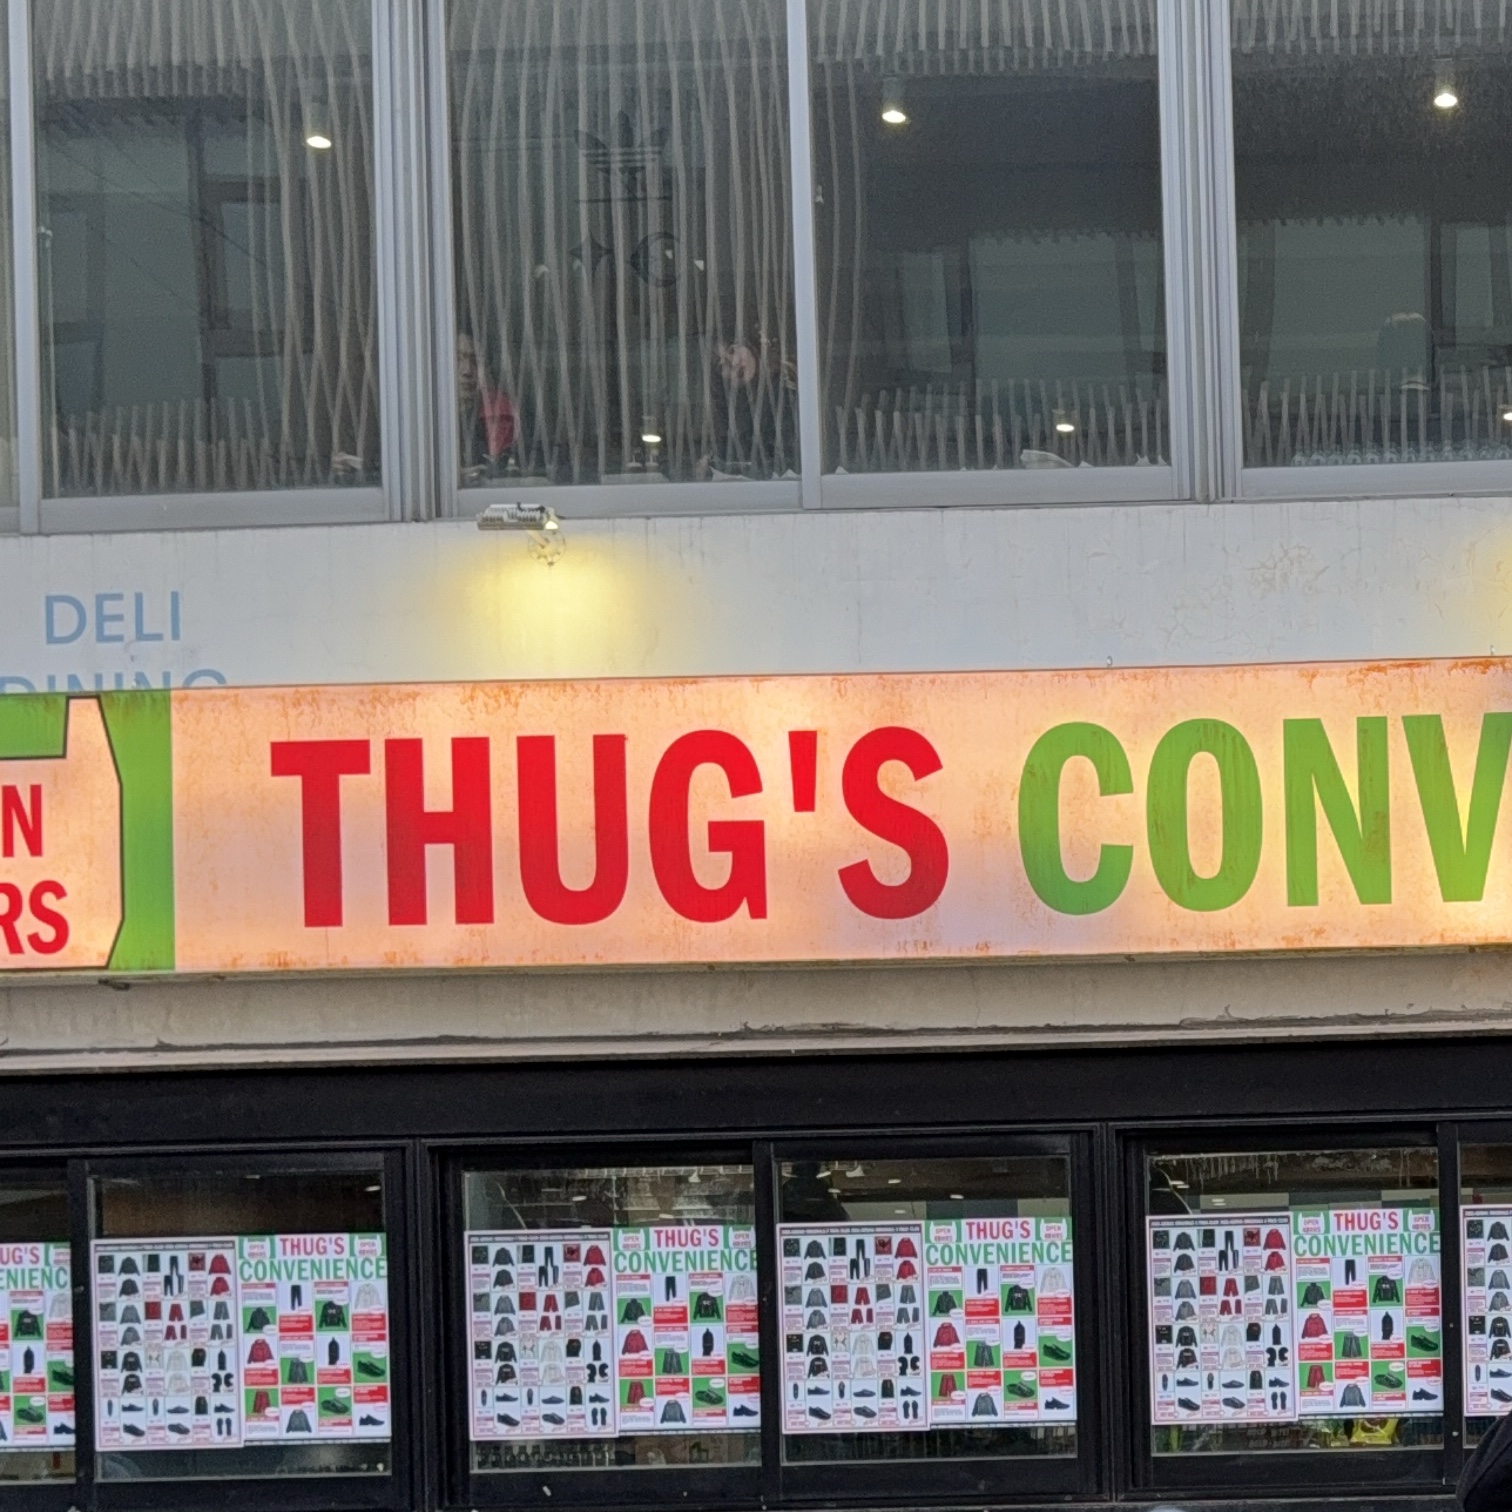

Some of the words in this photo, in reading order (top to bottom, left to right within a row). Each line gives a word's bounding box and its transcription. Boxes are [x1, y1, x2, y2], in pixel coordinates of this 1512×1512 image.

[45, 591, 180, 645] DELI
[269, 725, 950, 928] THUG'S
[966, 1220, 1031, 1240] THUG'S
[1334, 1211, 1399, 1231] THUG'S
[280, 1236, 345, 1257] THUG'S
[654, 1228, 719, 1248] THUG'S
[1294, 1232, 1440, 1257] CONVENIENCE
[925, 1241, 1073, 1265] CONVENIENCE
[239, 1257, 387, 1282] CONVENIENCE
